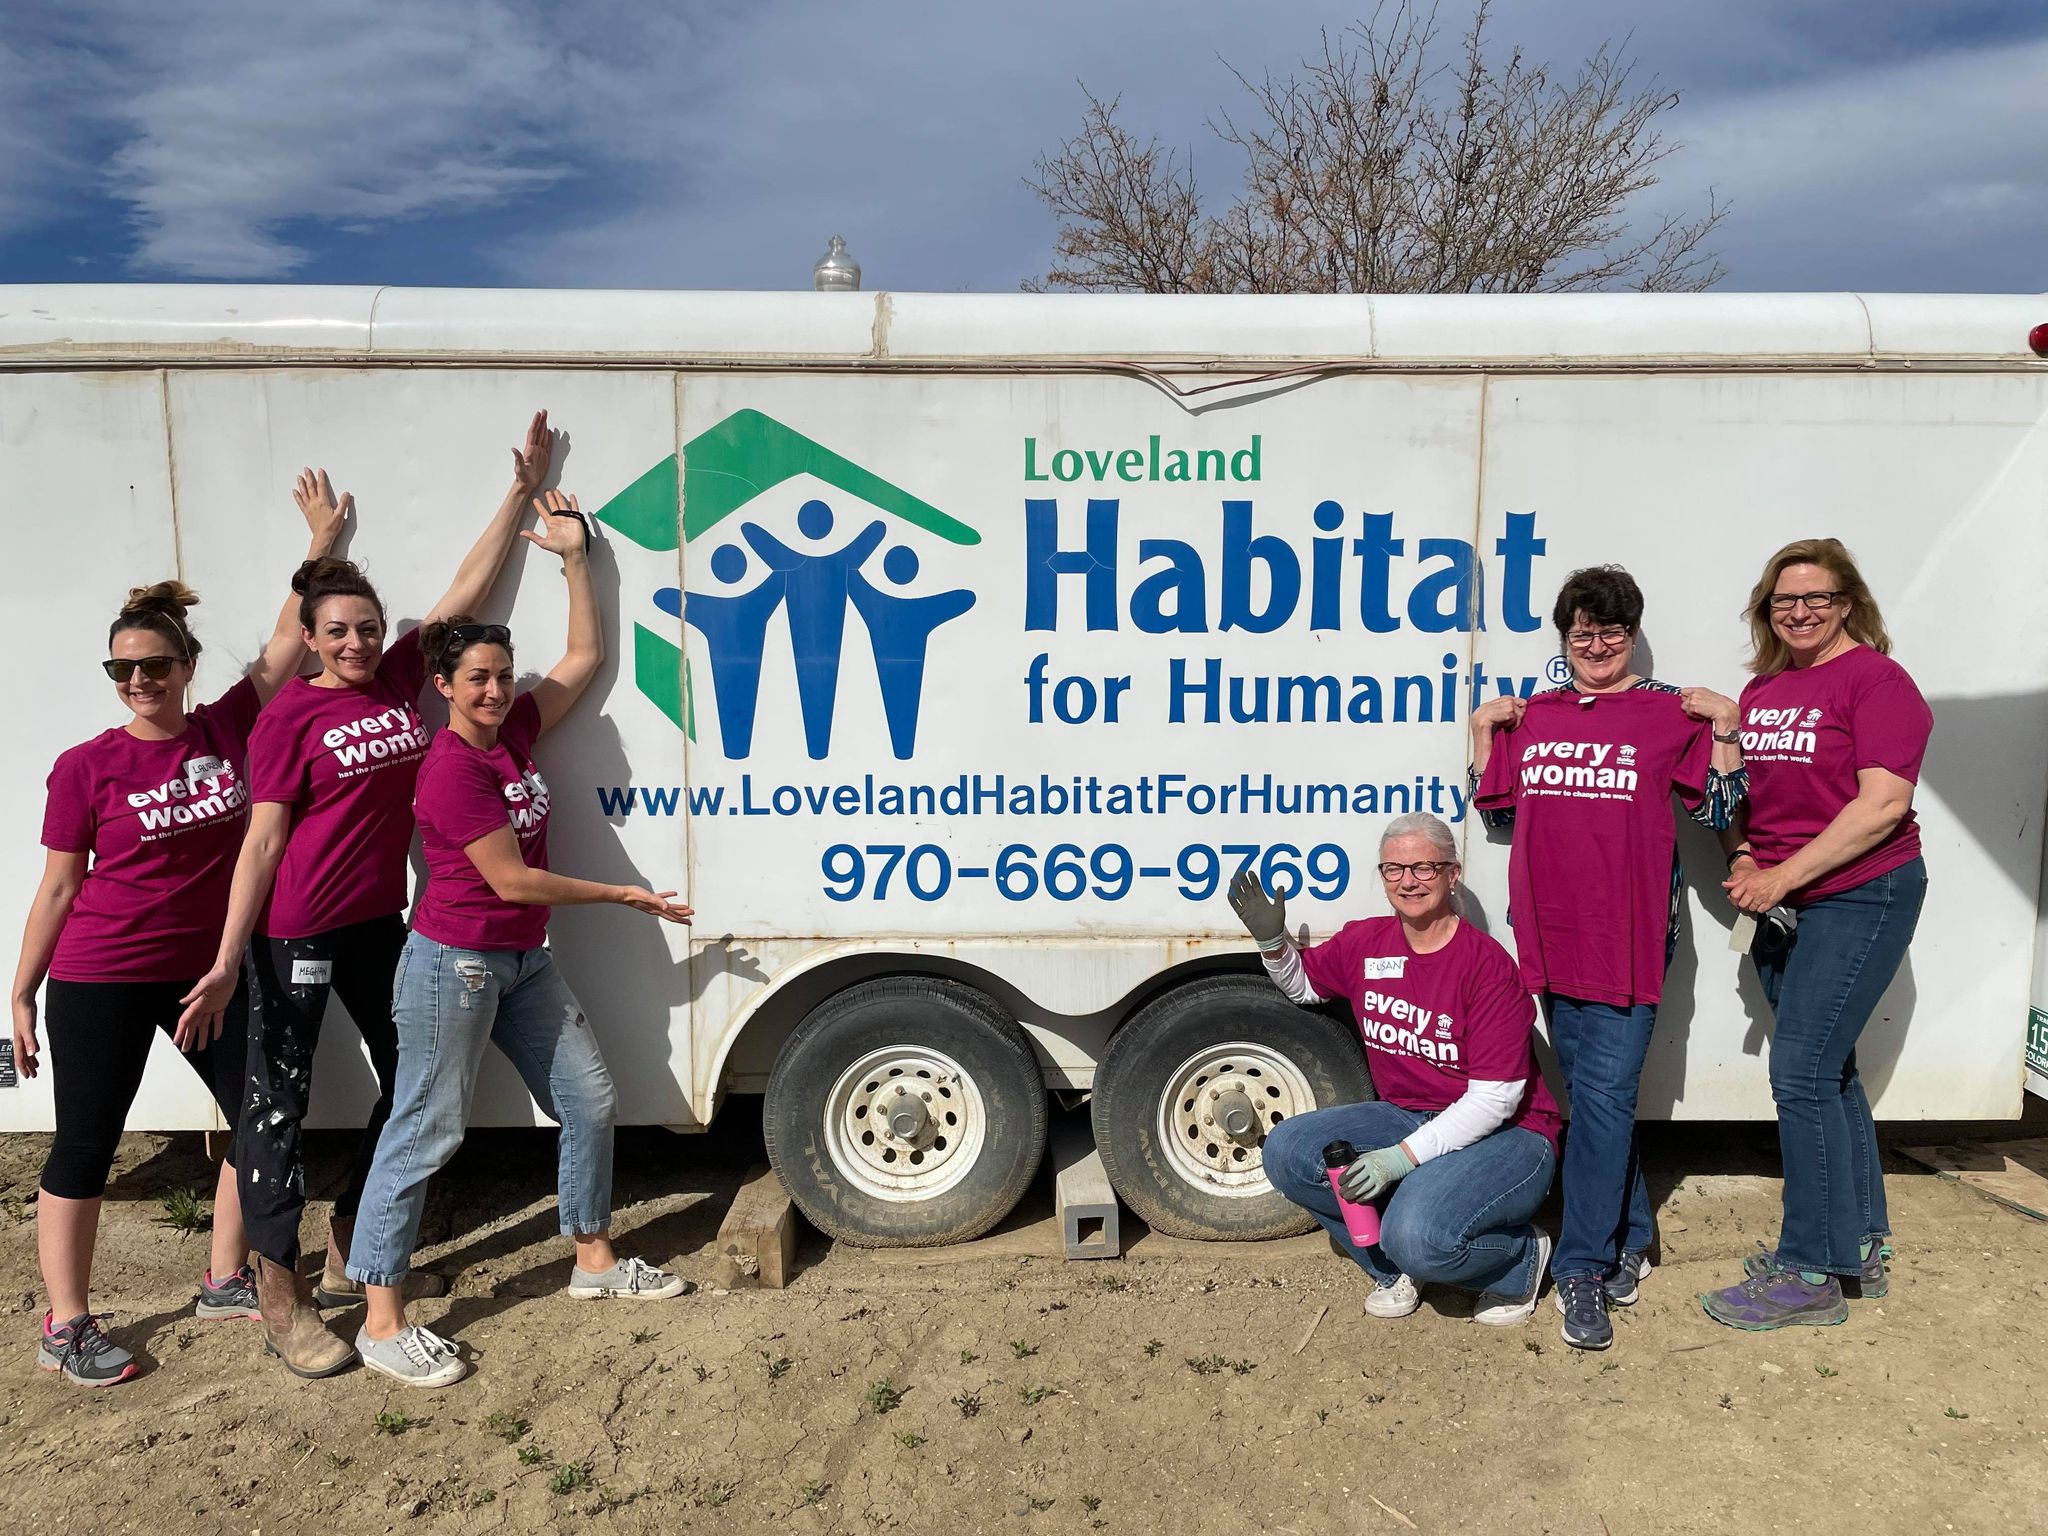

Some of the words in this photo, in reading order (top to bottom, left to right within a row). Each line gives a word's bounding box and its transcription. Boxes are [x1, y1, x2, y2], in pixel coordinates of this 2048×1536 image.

[1024, 435, 1262, 482] Loveland
[1024, 498, 1547, 633] Habitat
[1024, 653, 1131, 724] for
[322, 707, 411, 749] every
[1746, 707, 1804, 730] very
[338, 771, 354, 779] has
[355, 767, 369, 775] the
[1522, 742, 1613, 766] every
[127, 772, 221, 808] every
[1521, 765, 1638, 791] woman
[1572, 791, 1599, 799] change
[141, 833, 156, 842] has
[158, 829, 172, 839] the
[821, 843, 1350, 901] 970-669-9769
[1364, 990, 1432, 1035] every
[1363, 1017, 1459, 1061] woman
